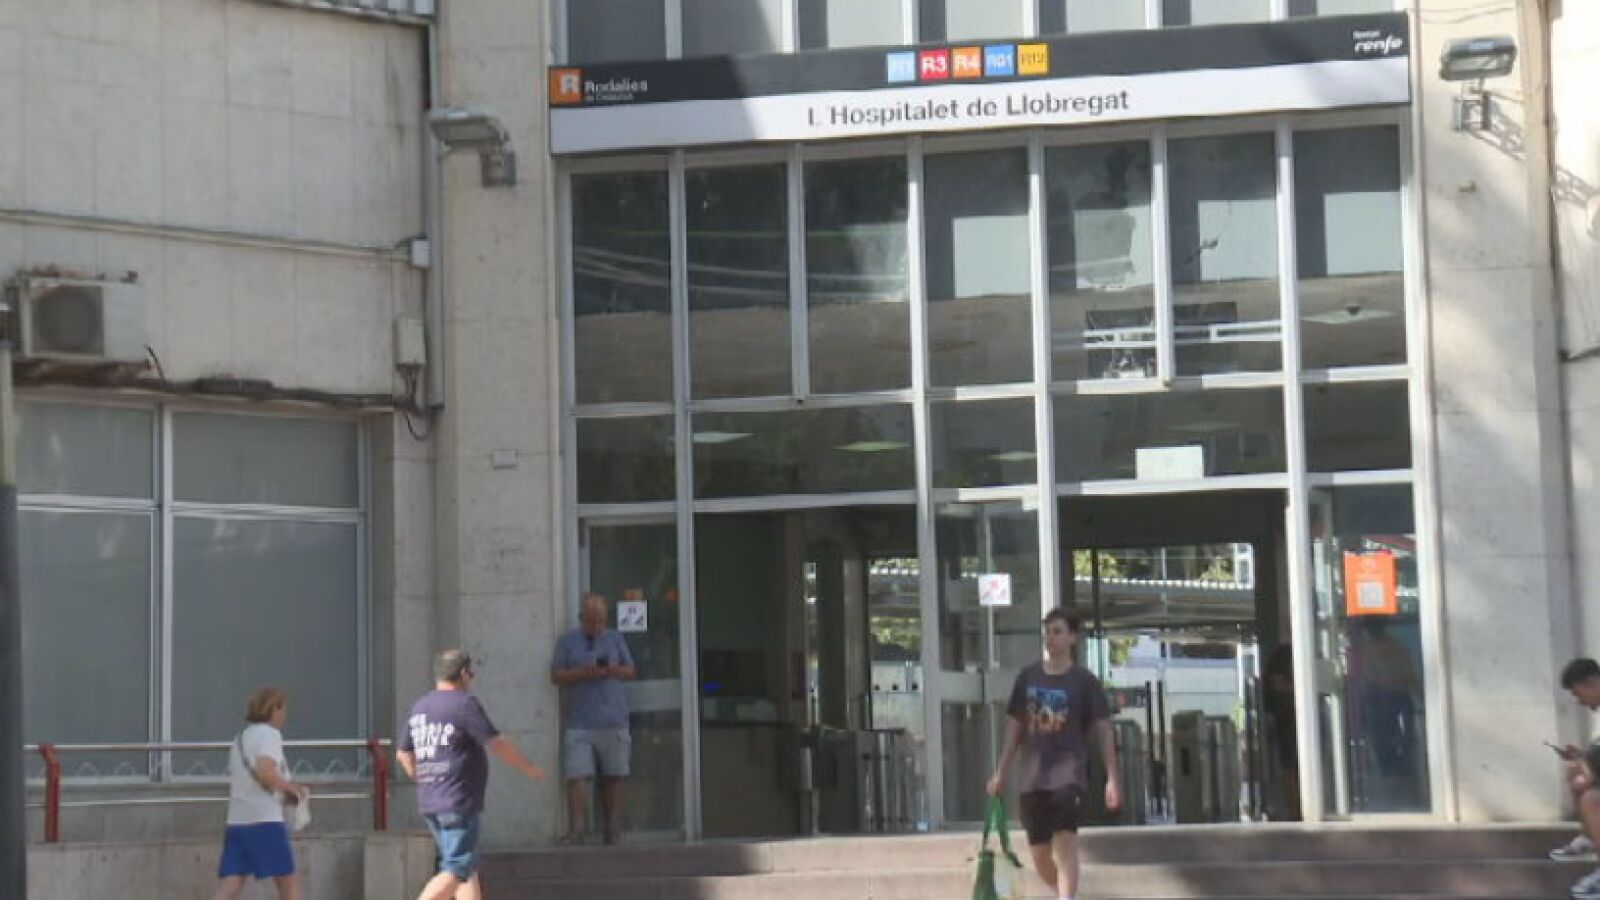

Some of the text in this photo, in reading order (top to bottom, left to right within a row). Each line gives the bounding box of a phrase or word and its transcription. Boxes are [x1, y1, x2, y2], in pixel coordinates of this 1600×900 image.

[921, 56, 947, 74] R3
[954, 54, 981, 71] R4
[561, 75, 580, 95] R
[584, 77, 648, 93] Rodalies
[966, 96, 997, 117] de
[1006, 89, 1129, 116] Llobregat
